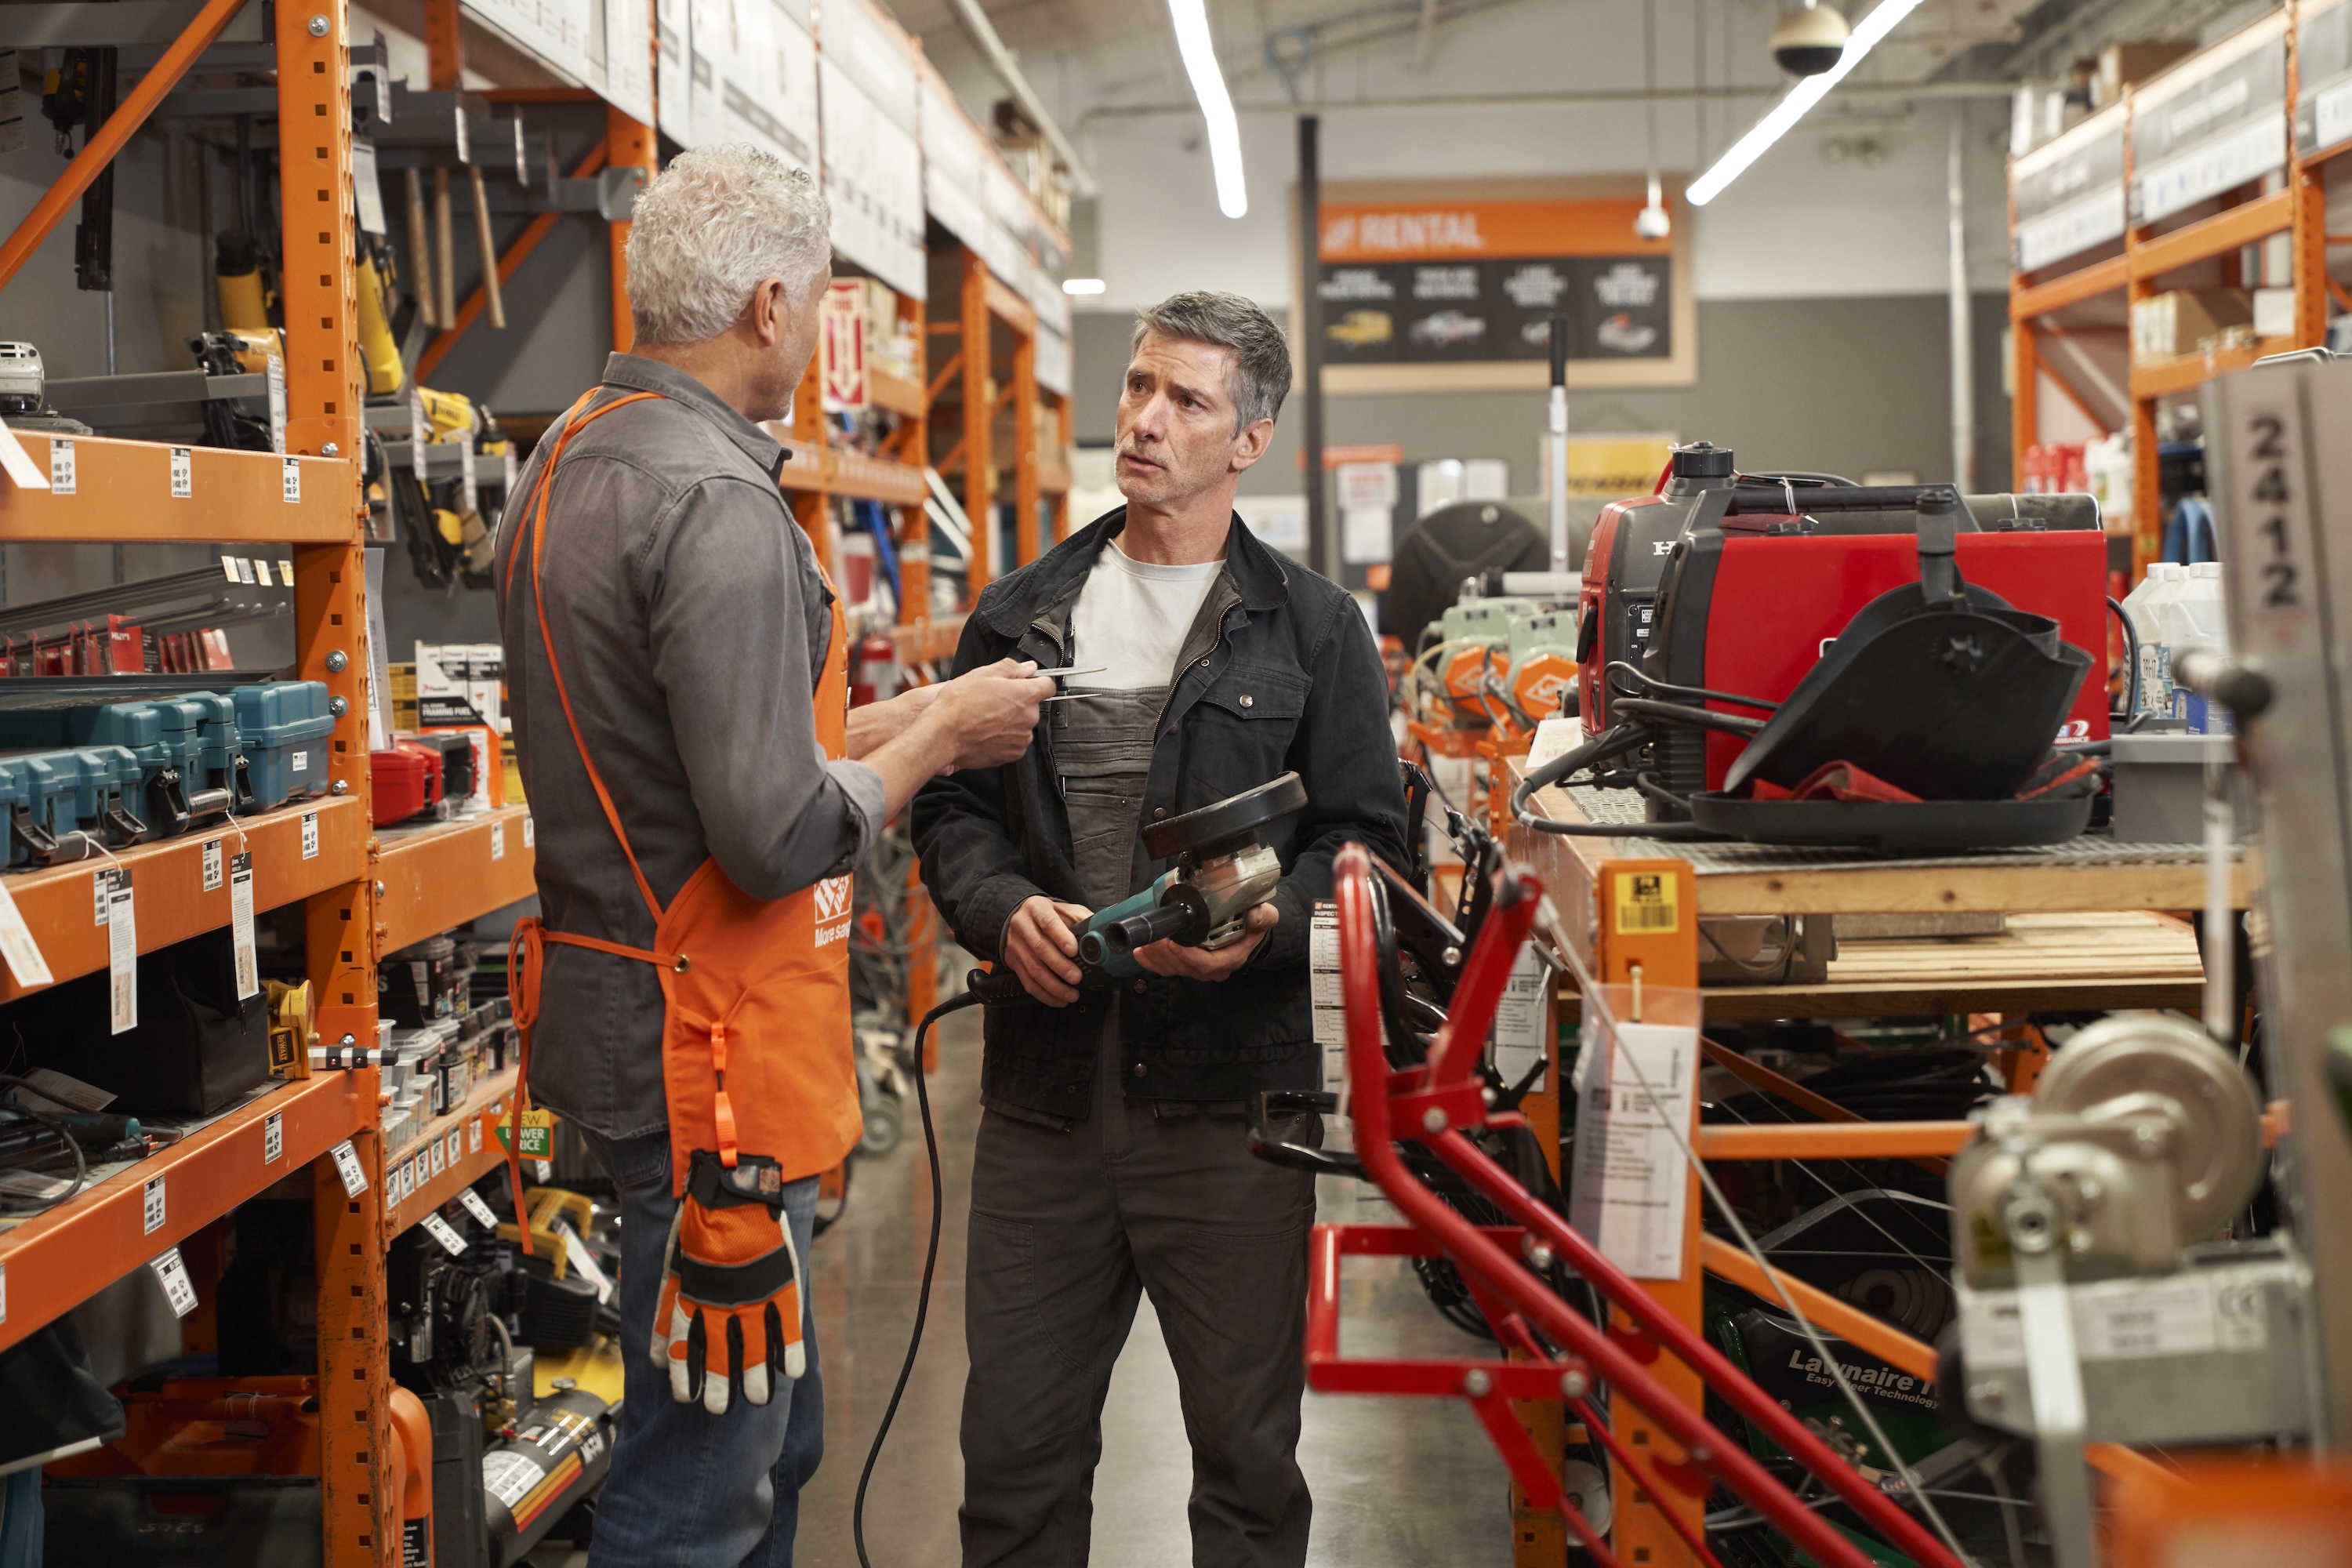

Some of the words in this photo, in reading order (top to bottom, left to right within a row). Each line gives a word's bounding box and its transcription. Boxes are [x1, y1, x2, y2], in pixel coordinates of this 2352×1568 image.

[1359, 213, 1483, 249] RENTAL
[423, 707, 453, 717] FRAMING
[455, 706, 471, 715] FUEL
[815, 927, 835, 948] More
[277, 1033, 289, 1062] DEWALT
[506, 1127, 545, 1139] LWER
[519, 1139, 541, 1151] RICE
[1806, 1373, 1835, 1388] Easy
[1874, 1385, 1940, 1410] Technology
